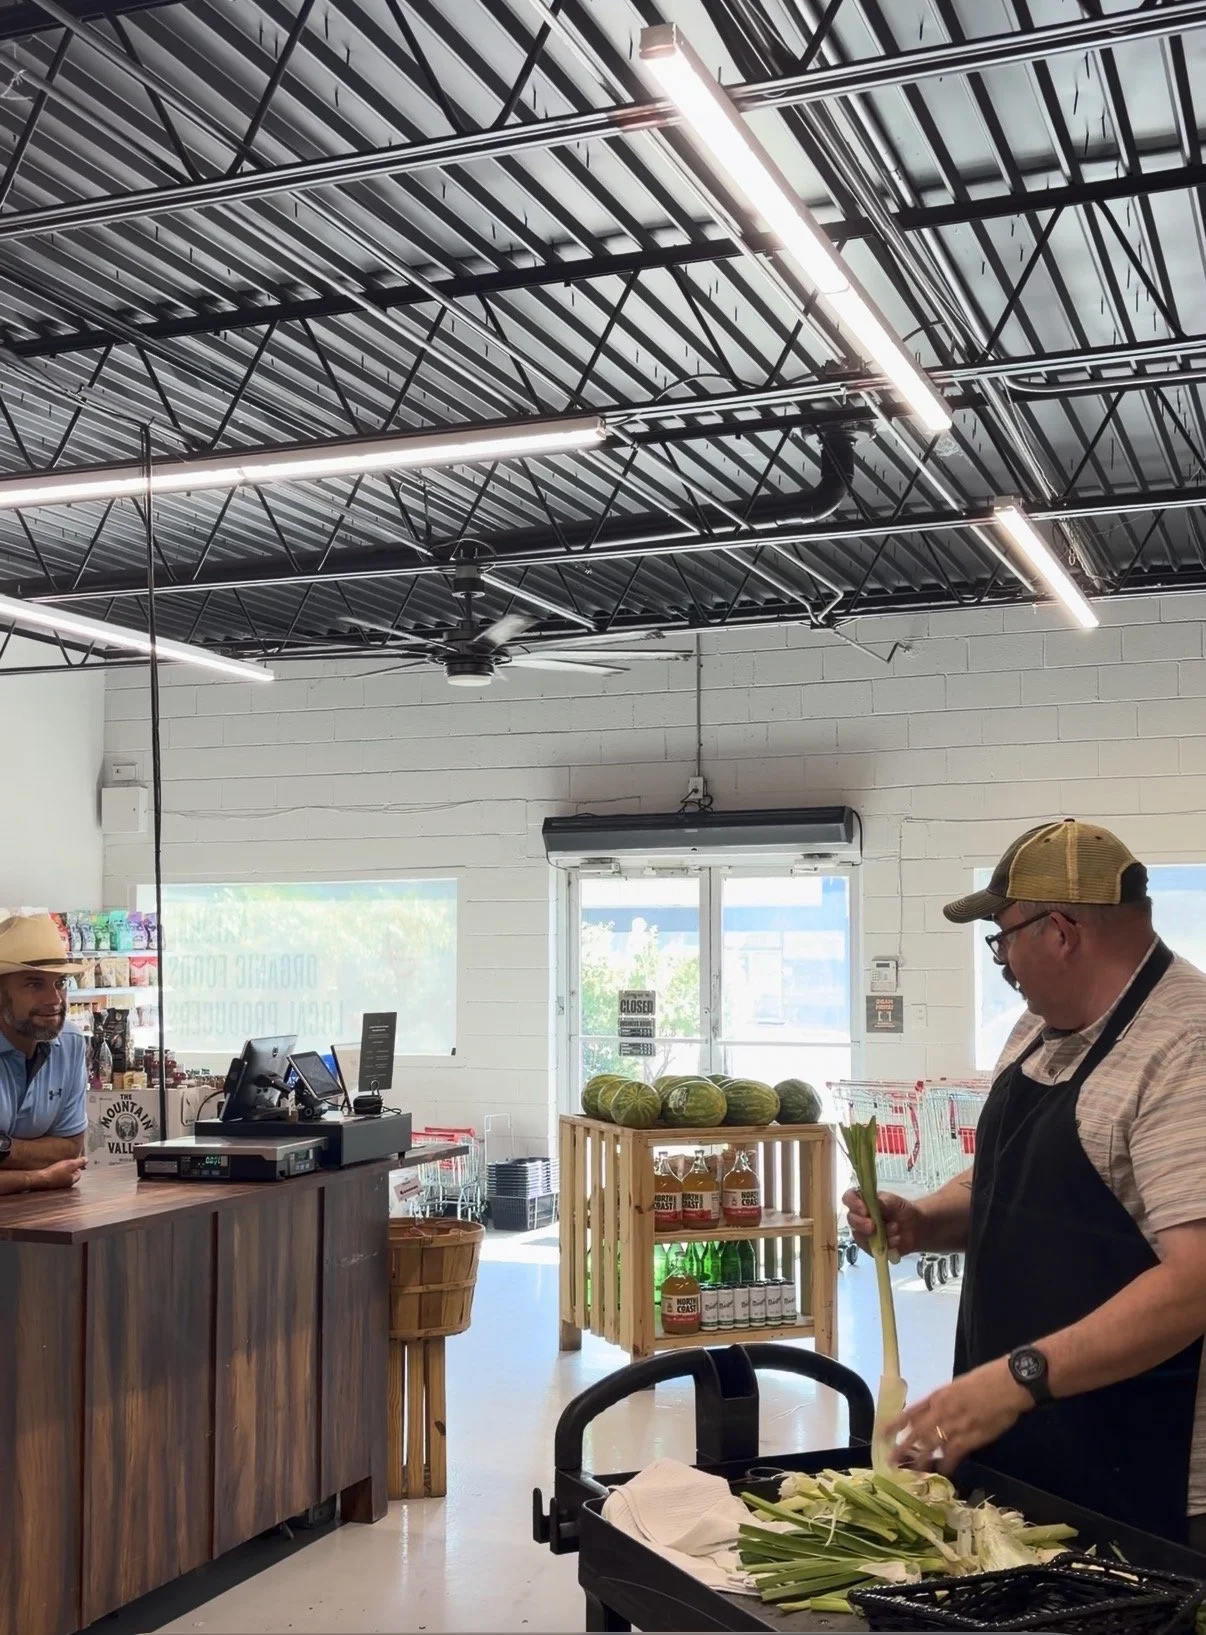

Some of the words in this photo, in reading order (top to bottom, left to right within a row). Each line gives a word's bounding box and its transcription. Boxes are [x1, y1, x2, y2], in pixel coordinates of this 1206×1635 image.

[620, 999, 654, 1014] CLOSED
[101, 1101, 153, 1130] MOUNTAIN
[741, 1198, 758, 1206] COAS
[677, 1297, 697, 1305] NORTH
[677, 1304, 697, 1313] COAST
